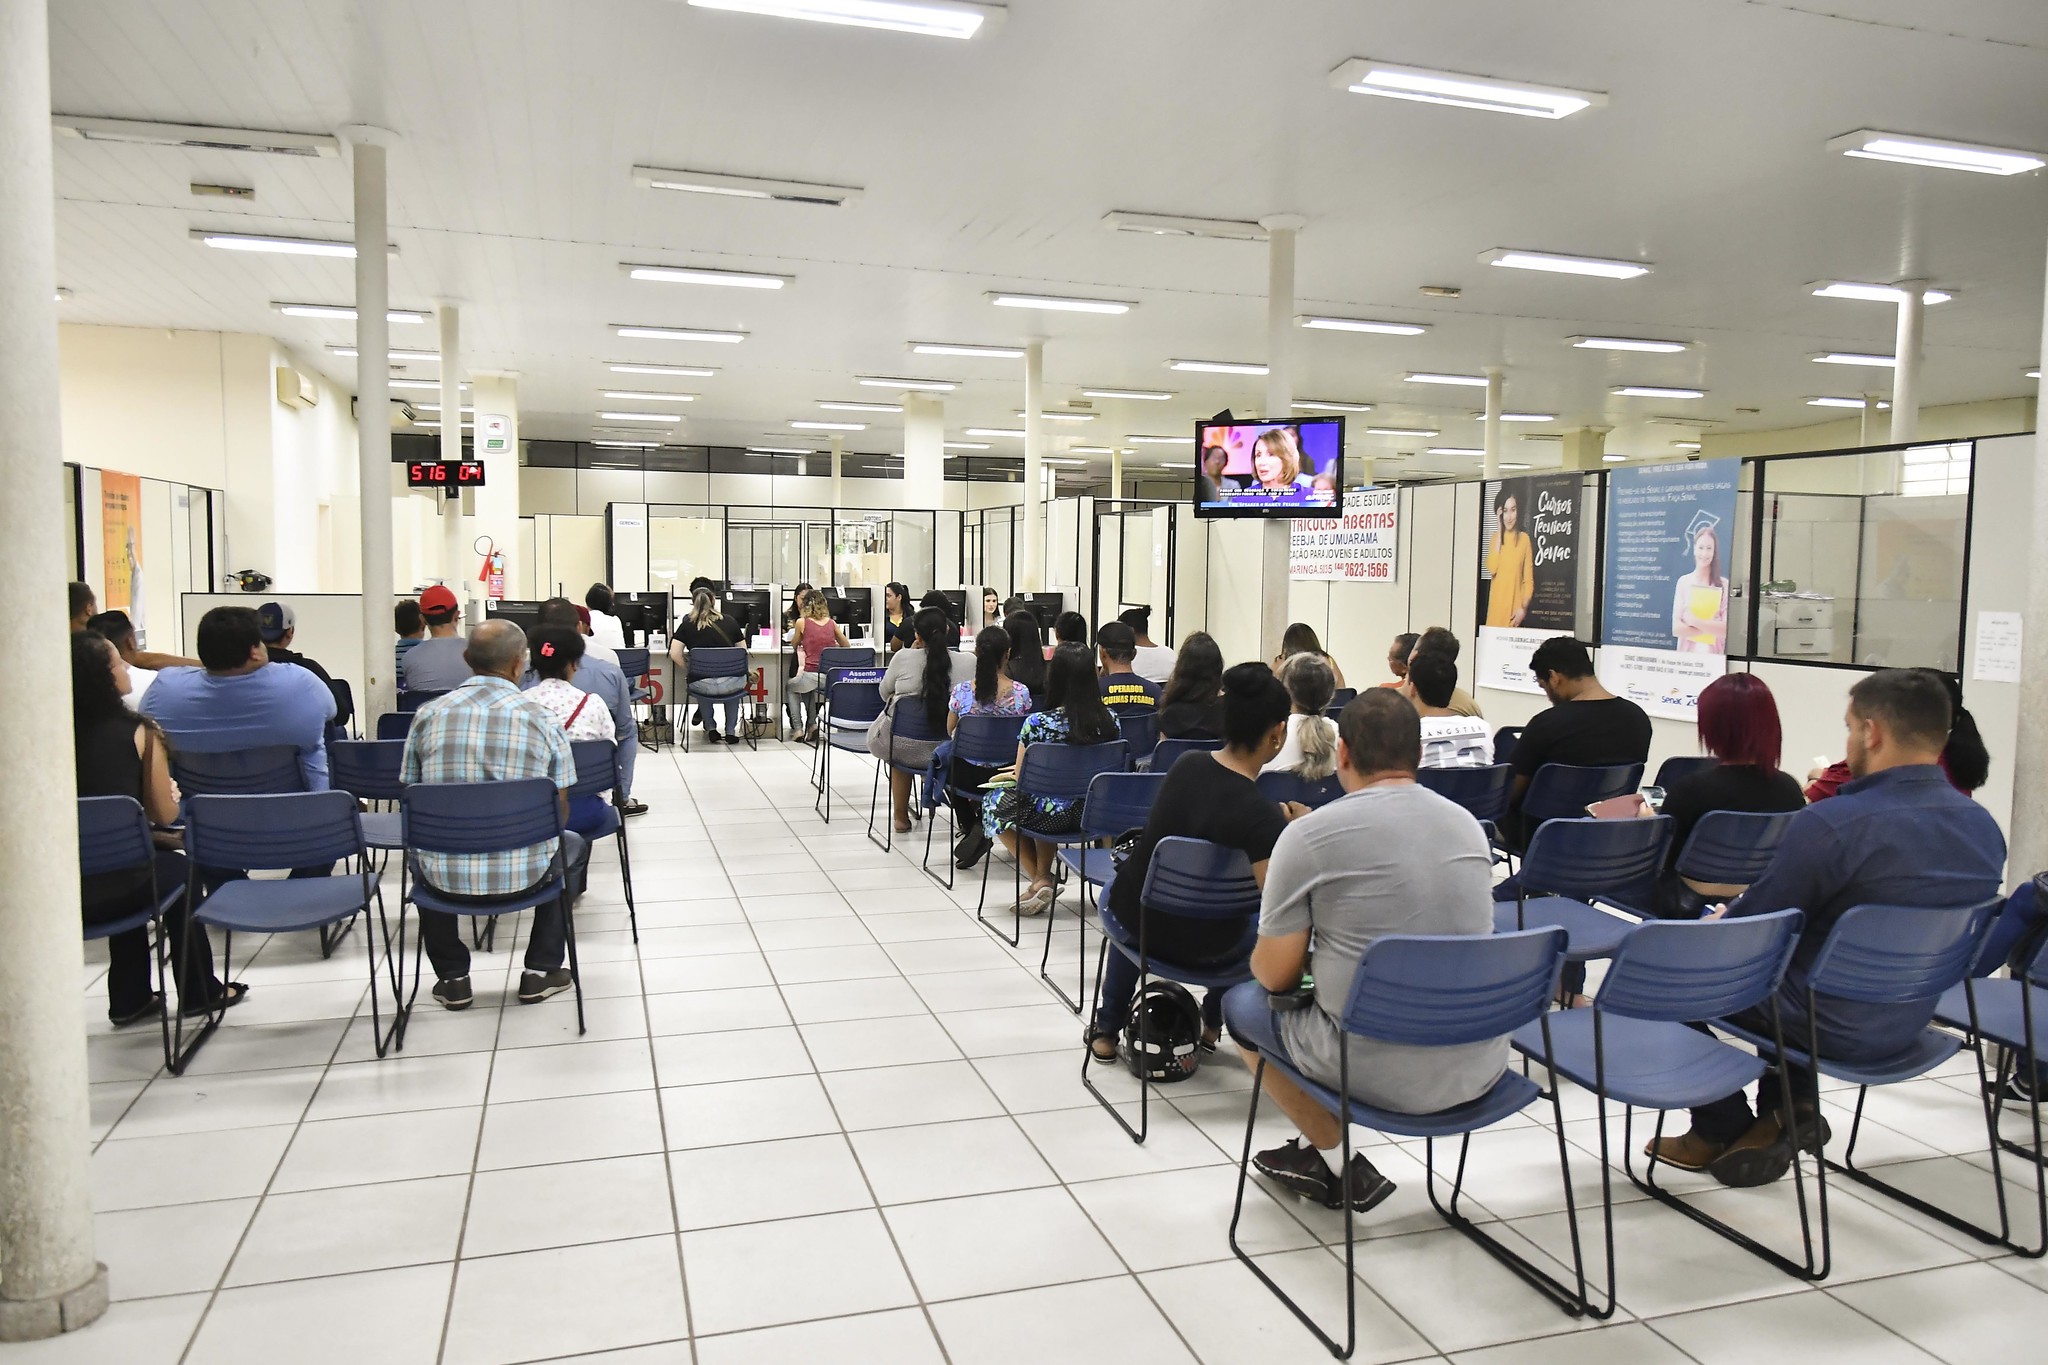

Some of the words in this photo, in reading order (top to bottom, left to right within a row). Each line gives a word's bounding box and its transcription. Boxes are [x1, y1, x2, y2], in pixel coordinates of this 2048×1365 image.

[411, 465, 446, 480] 516
[1364, 493, 1391, 507] ESTUDE
[1538, 490, 1572, 516] Cursos
[1343, 512, 1395, 530] ABERTAS
[1533, 513, 1572, 538] Técnicos
[1290, 534, 1315, 546] EEBJA
[1319, 534, 1327, 545] DE
[1329, 532, 1378, 545] UMUARAMA
[1325, 548, 1352, 559] JOVENS
[1354, 548, 1358, 558] E
[1360, 547, 1392, 558] ADULTOS
[1534, 535, 1571, 566] Senac
[1345, 562, 1388, 577] 3623-1566
[639, 668, 664, 704] 5
[1108, 684, 1144, 694] OPERADOR
[1129, 695, 1155, 705] PESADAS
[1420, 725, 1482, 738] ANGSTER
